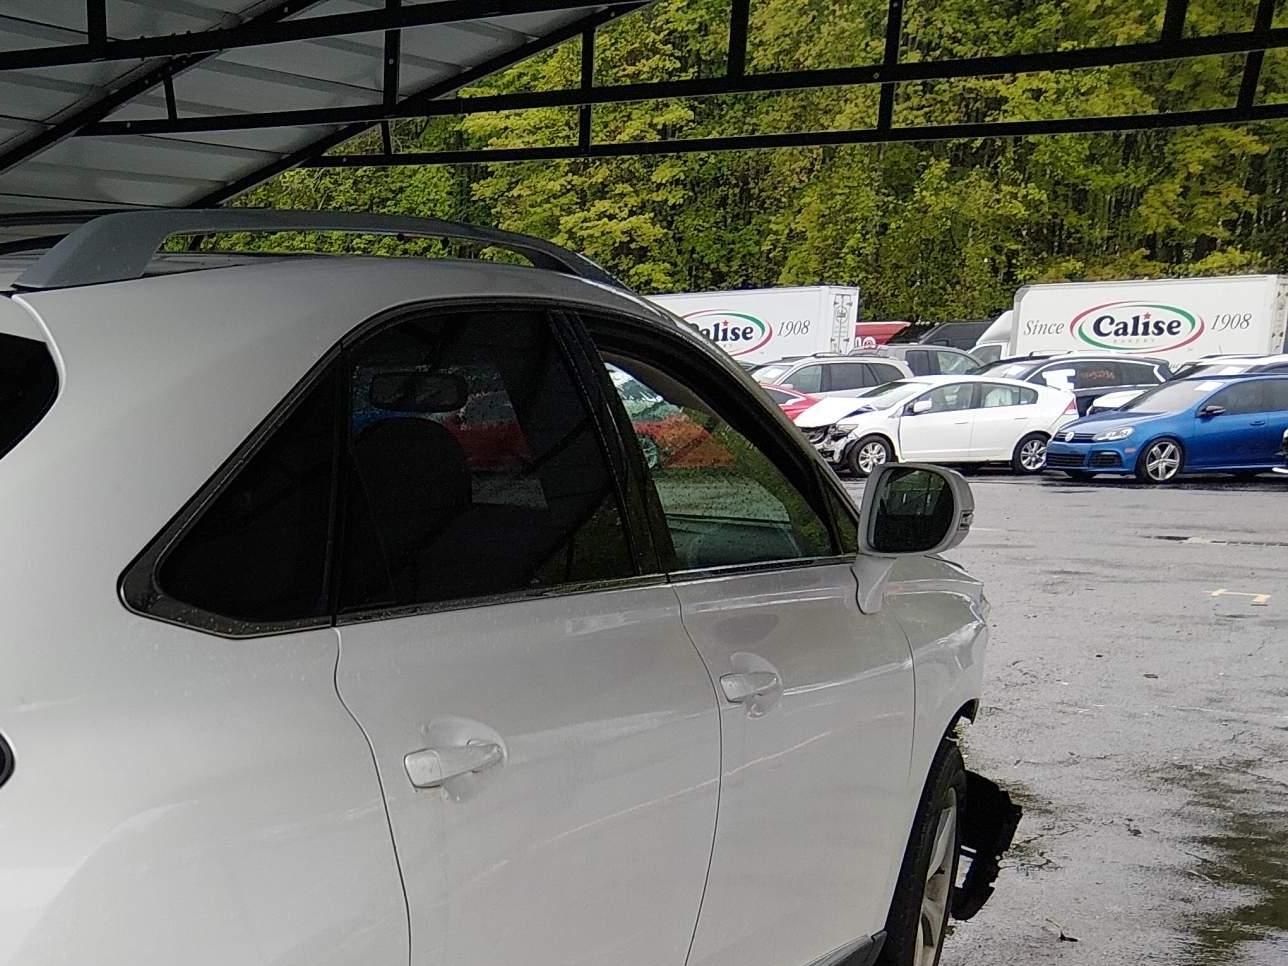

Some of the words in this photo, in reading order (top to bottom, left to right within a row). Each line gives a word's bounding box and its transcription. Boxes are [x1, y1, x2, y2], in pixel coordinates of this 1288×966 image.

[776, 319, 811, 338] 1908
[1023, 319, 1065, 337] Since
[1092, 312, 1182, 338] Calise
[1210, 312, 1253, 332] 1908
